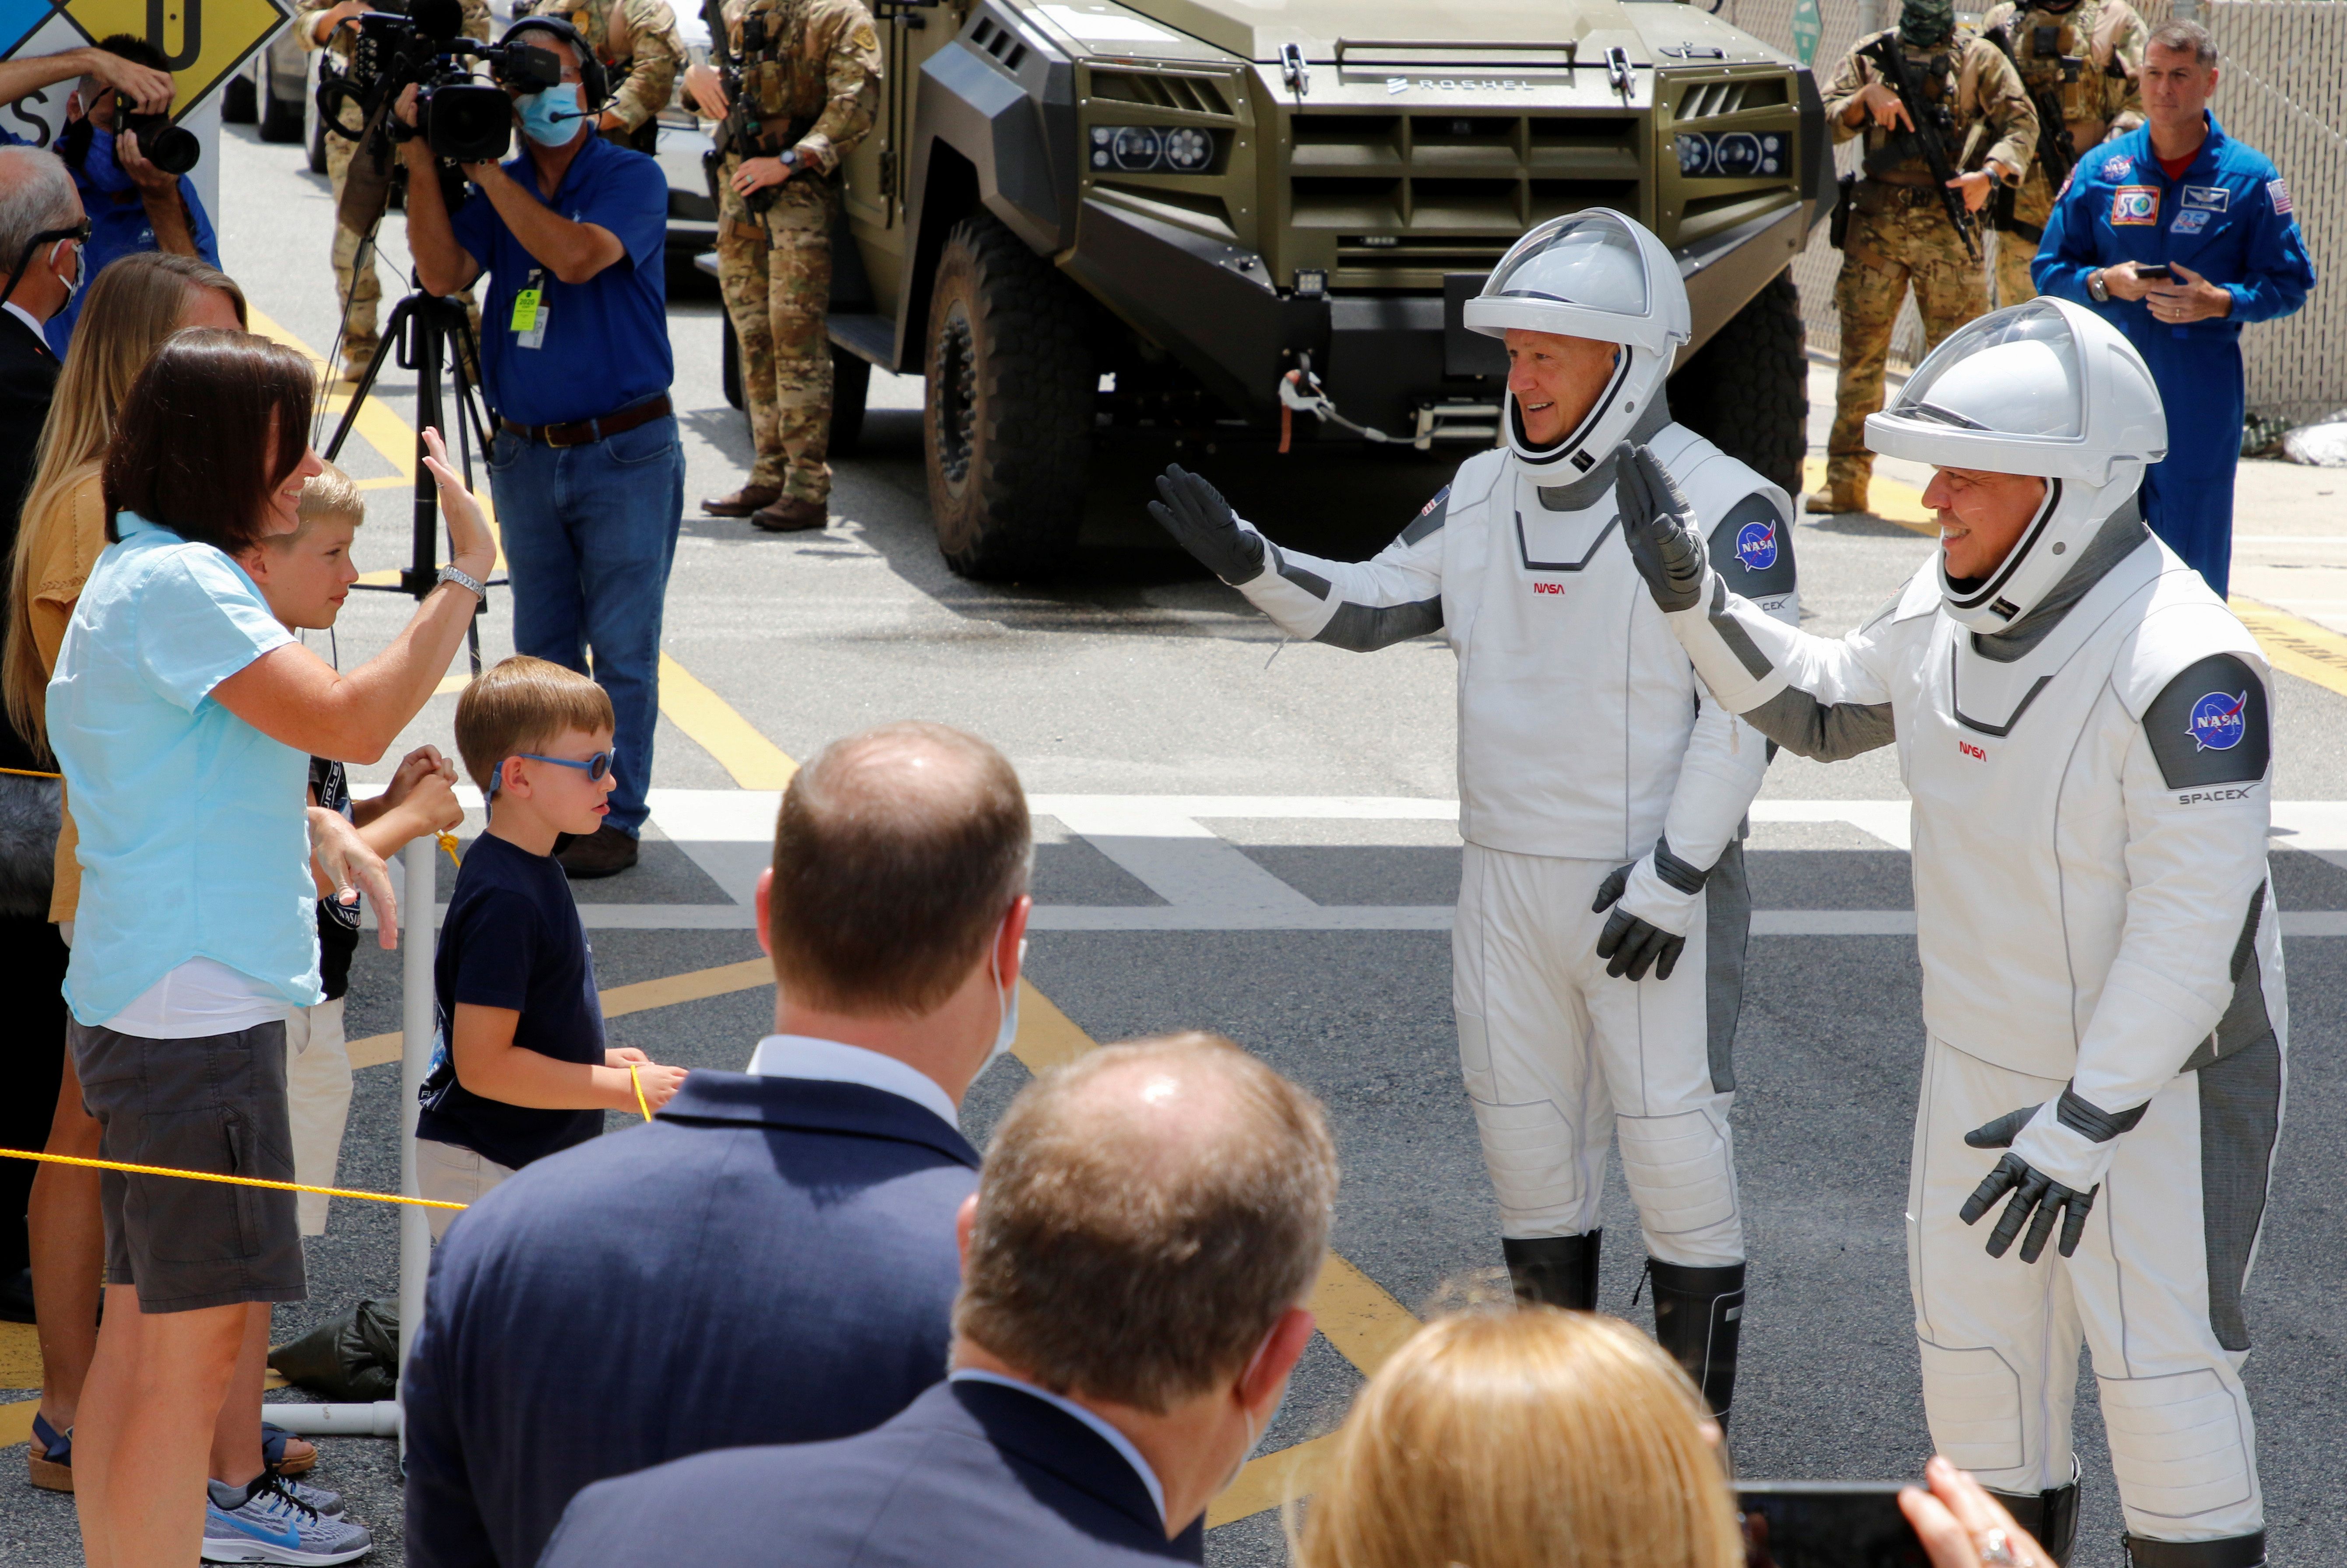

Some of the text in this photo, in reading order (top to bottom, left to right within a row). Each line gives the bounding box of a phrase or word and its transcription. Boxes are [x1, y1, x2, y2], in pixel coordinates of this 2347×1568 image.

[1419, 79, 1534, 90] ROSHEL
[11, 90, 50, 148] S
[2104, 162, 2130, 174] NASA
[1742, 540, 1774, 552] NASA
[1534, 583, 1565, 594] NASA
[1757, 595, 1791, 611] CEX
[2196, 714, 2241, 728] NASA
[1959, 741, 1987, 762] NASA
[324, 760, 339, 809] URLE
[2178, 783, 2260, 805] SPACEX
